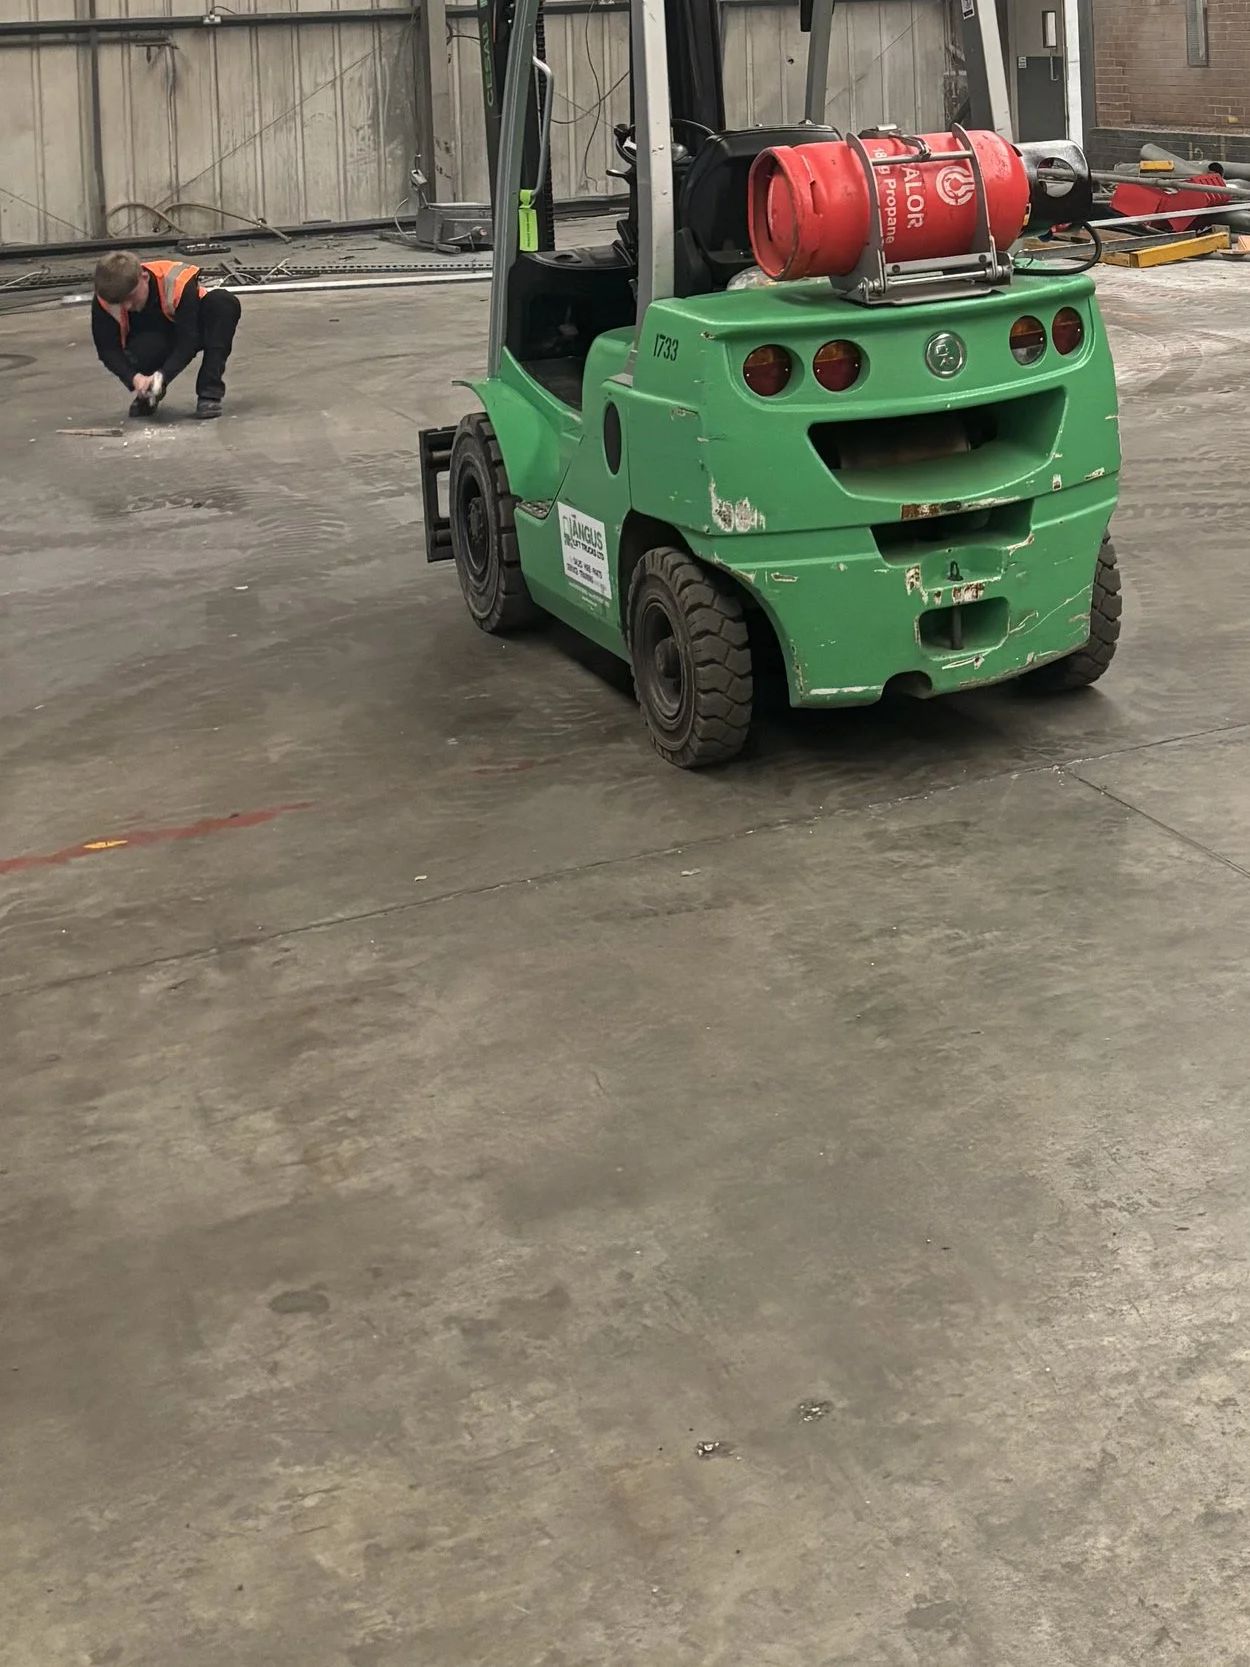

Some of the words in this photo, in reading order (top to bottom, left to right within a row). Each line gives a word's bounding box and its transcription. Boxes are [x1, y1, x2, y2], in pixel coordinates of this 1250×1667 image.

[883, 178, 897, 244] Propane
[901, 162, 925, 229] ALOR
[653, 333, 679, 361] 1733
[572, 519, 604, 551] ANGUS
